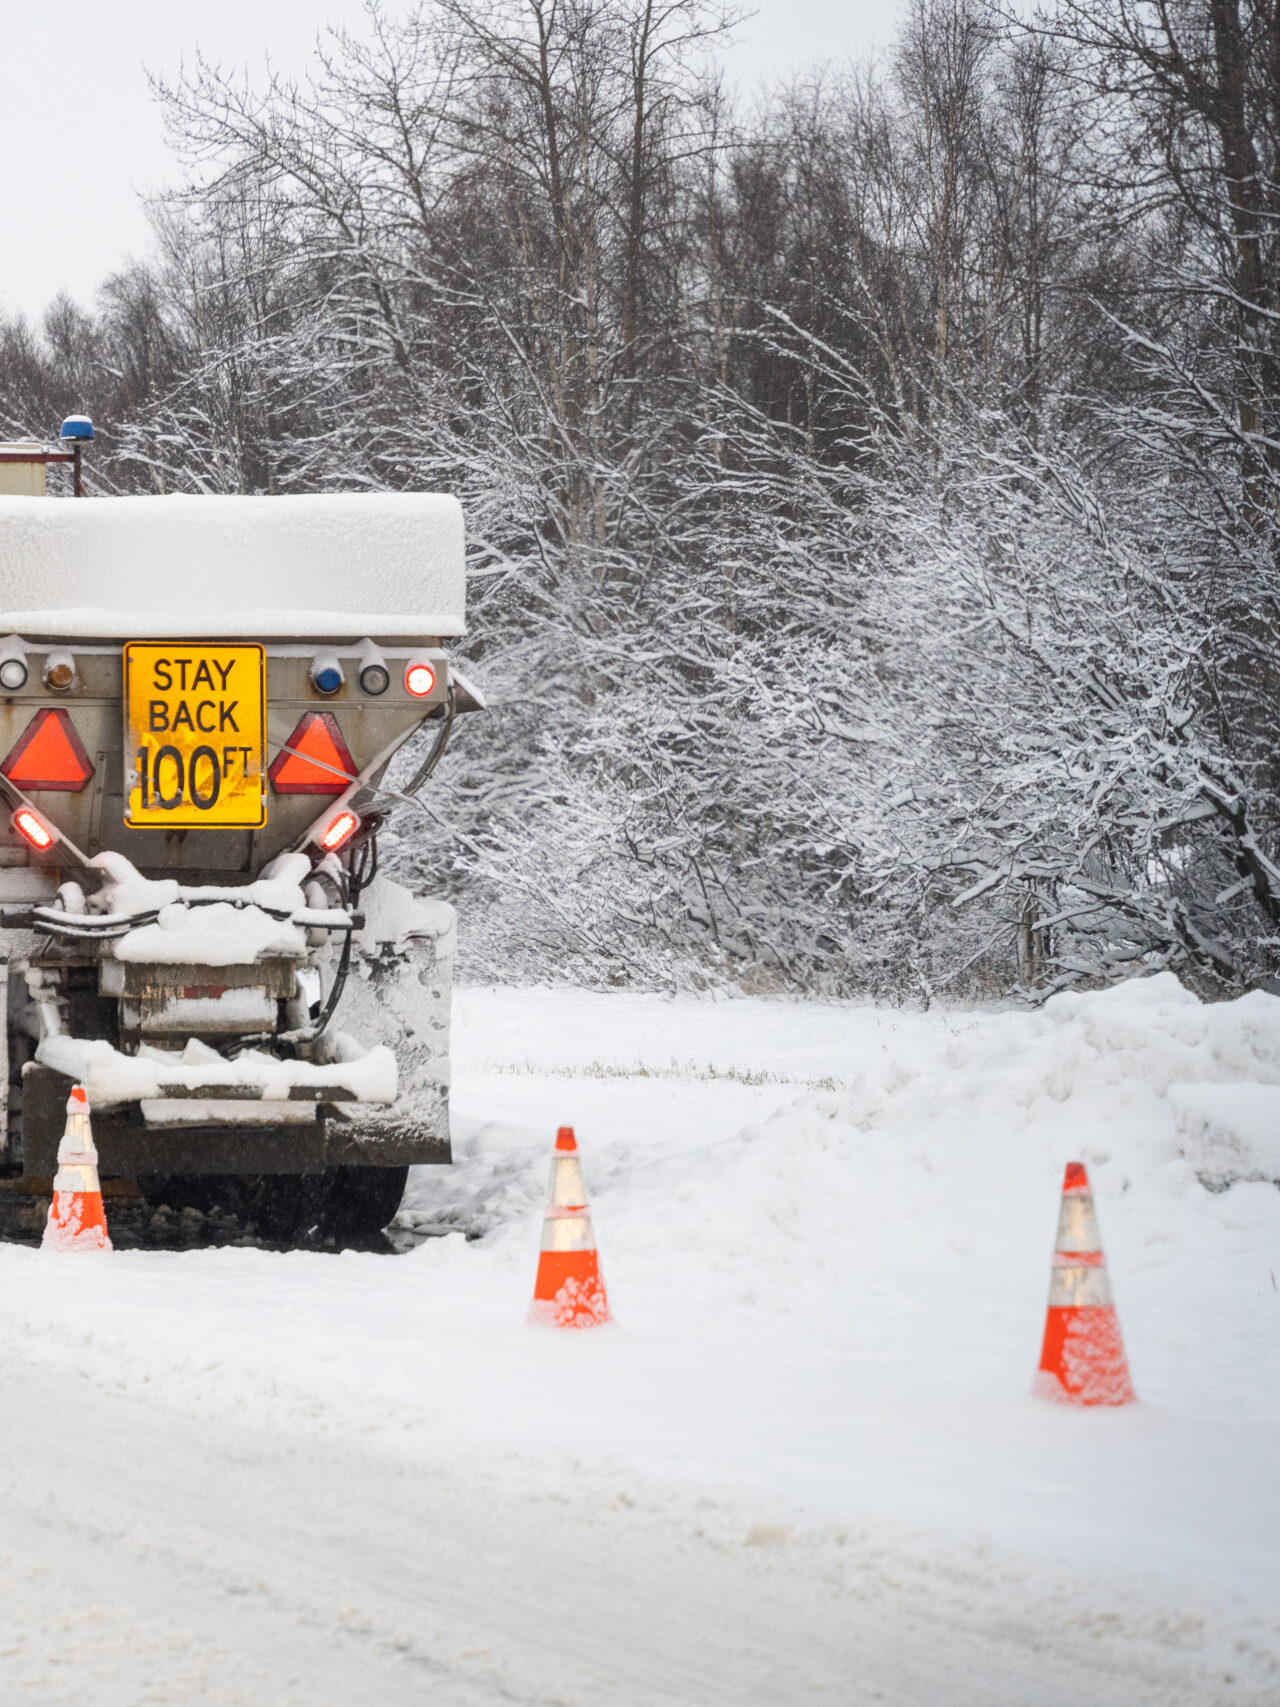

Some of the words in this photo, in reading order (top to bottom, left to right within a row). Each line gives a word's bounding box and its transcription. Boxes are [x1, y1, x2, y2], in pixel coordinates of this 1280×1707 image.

[153, 658, 236, 691] STAY
[149, 700, 240, 733] BACK
[137, 744, 221, 810] 100
[223, 746, 253, 779] FT
